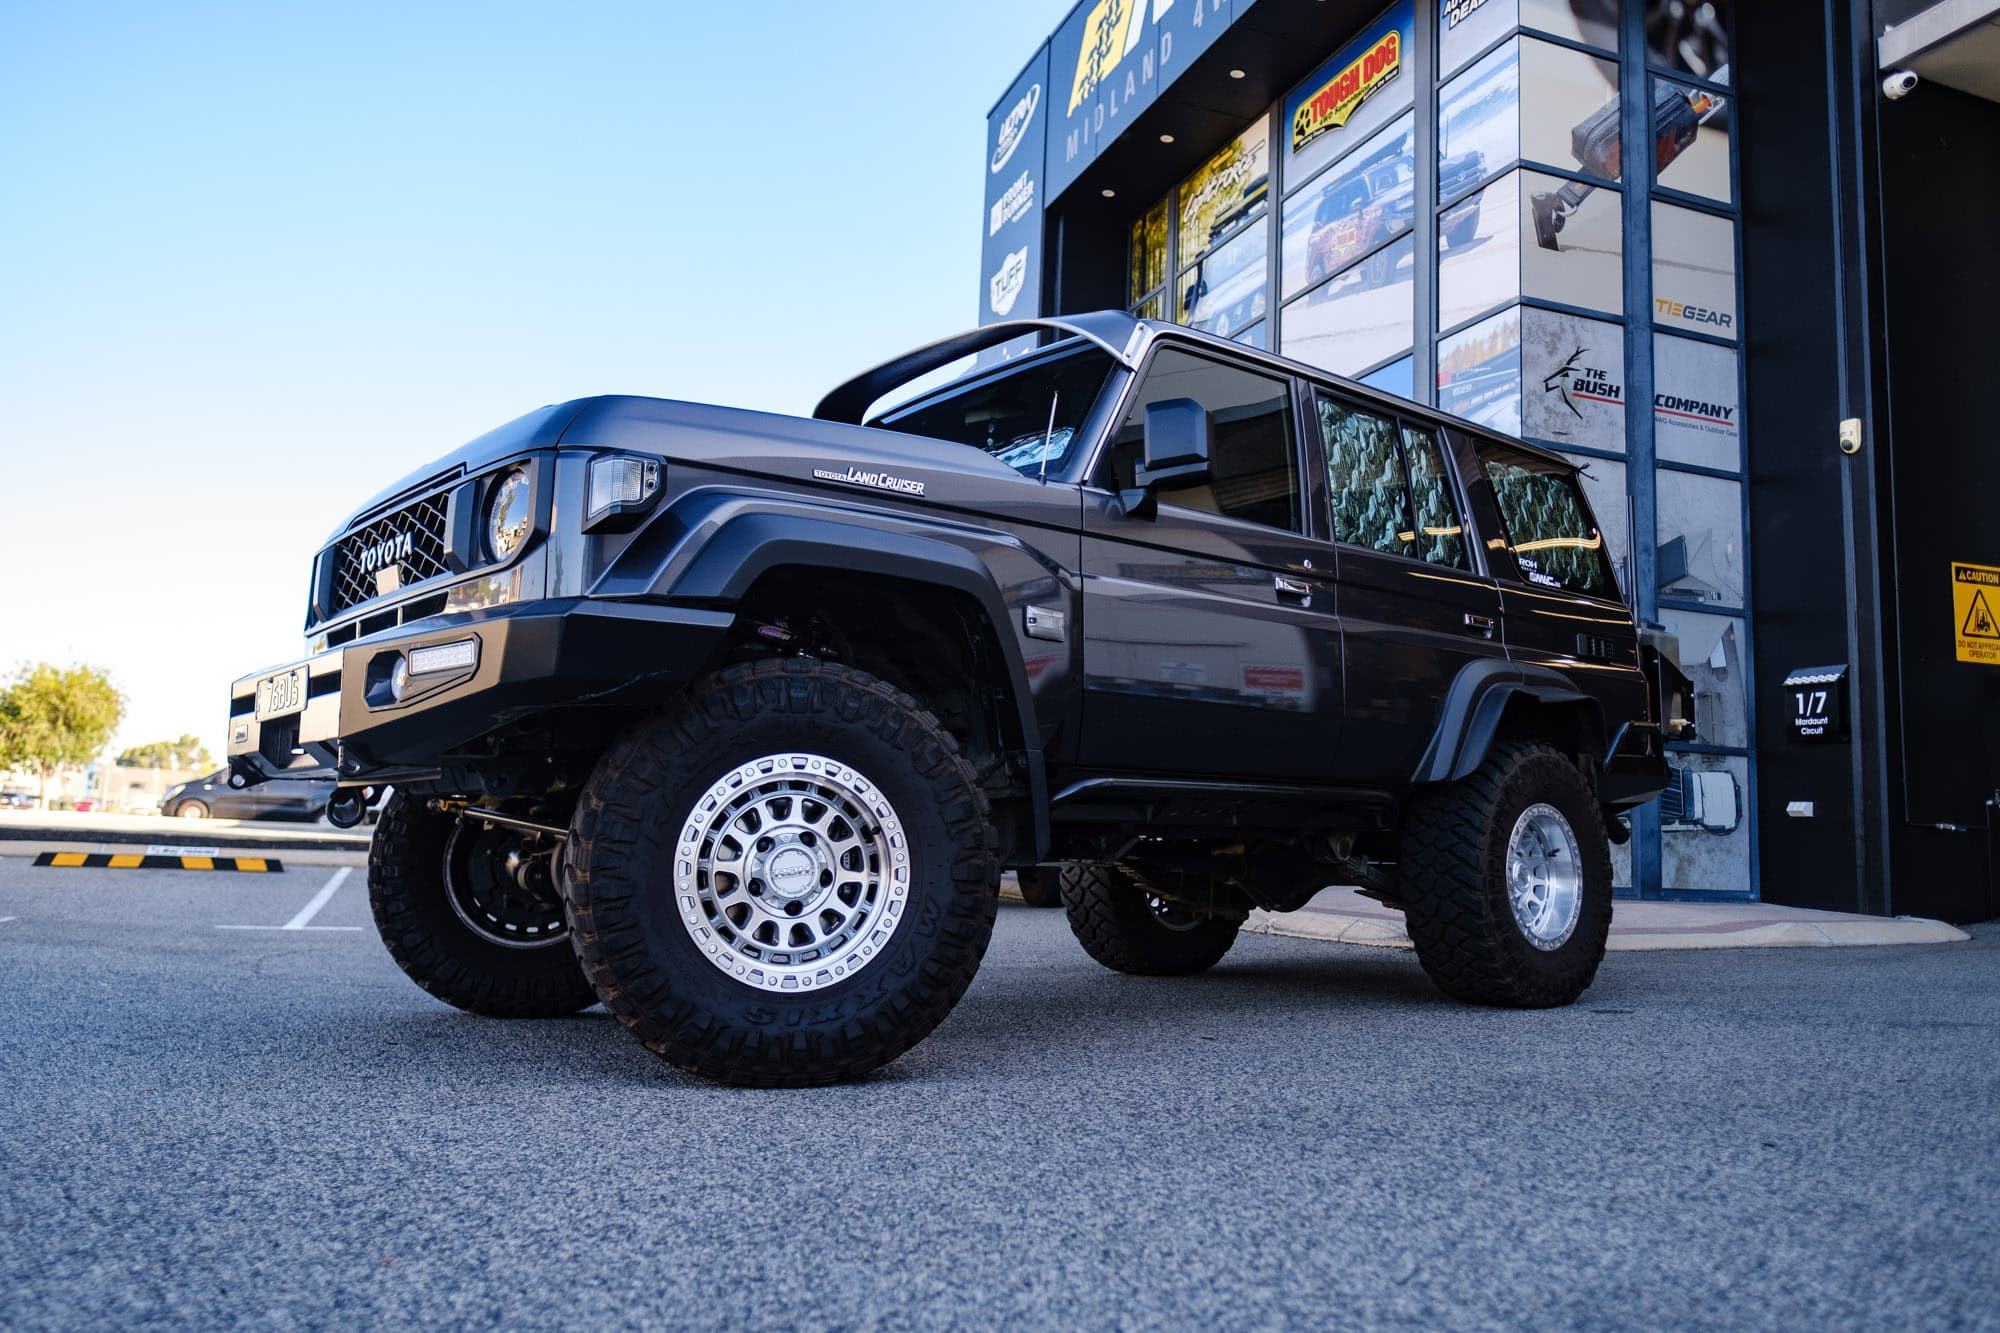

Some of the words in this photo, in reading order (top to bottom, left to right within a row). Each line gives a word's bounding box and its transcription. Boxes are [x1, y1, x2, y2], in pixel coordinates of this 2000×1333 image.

[1310, 63, 1360, 124] TOUGH
[1363, 35, 1397, 85] DOG
[1066, 31, 1173, 163] MIDLAND
[995, 259, 1022, 299] TUFF
[1656, 298, 1732, 328] TIEGEAR
[1585, 367, 1607, 380] THE
[1573, 378, 1621, 399] BUSH
[1655, 393, 1733, 419] COMPANY
[360, 531, 412, 574] TOYOTA
[1518, 557, 1537, 569] ROH
[1966, 570, 1999, 585] CAUTION
[1958, 640, 1966, 648] DO
[1966, 641, 1978, 650] NOT
[1795, 691, 1827, 717] 1/7
[1795, 717, 1828, 726] Mordaunt
[1800, 727, 1823, 735] Circuit
